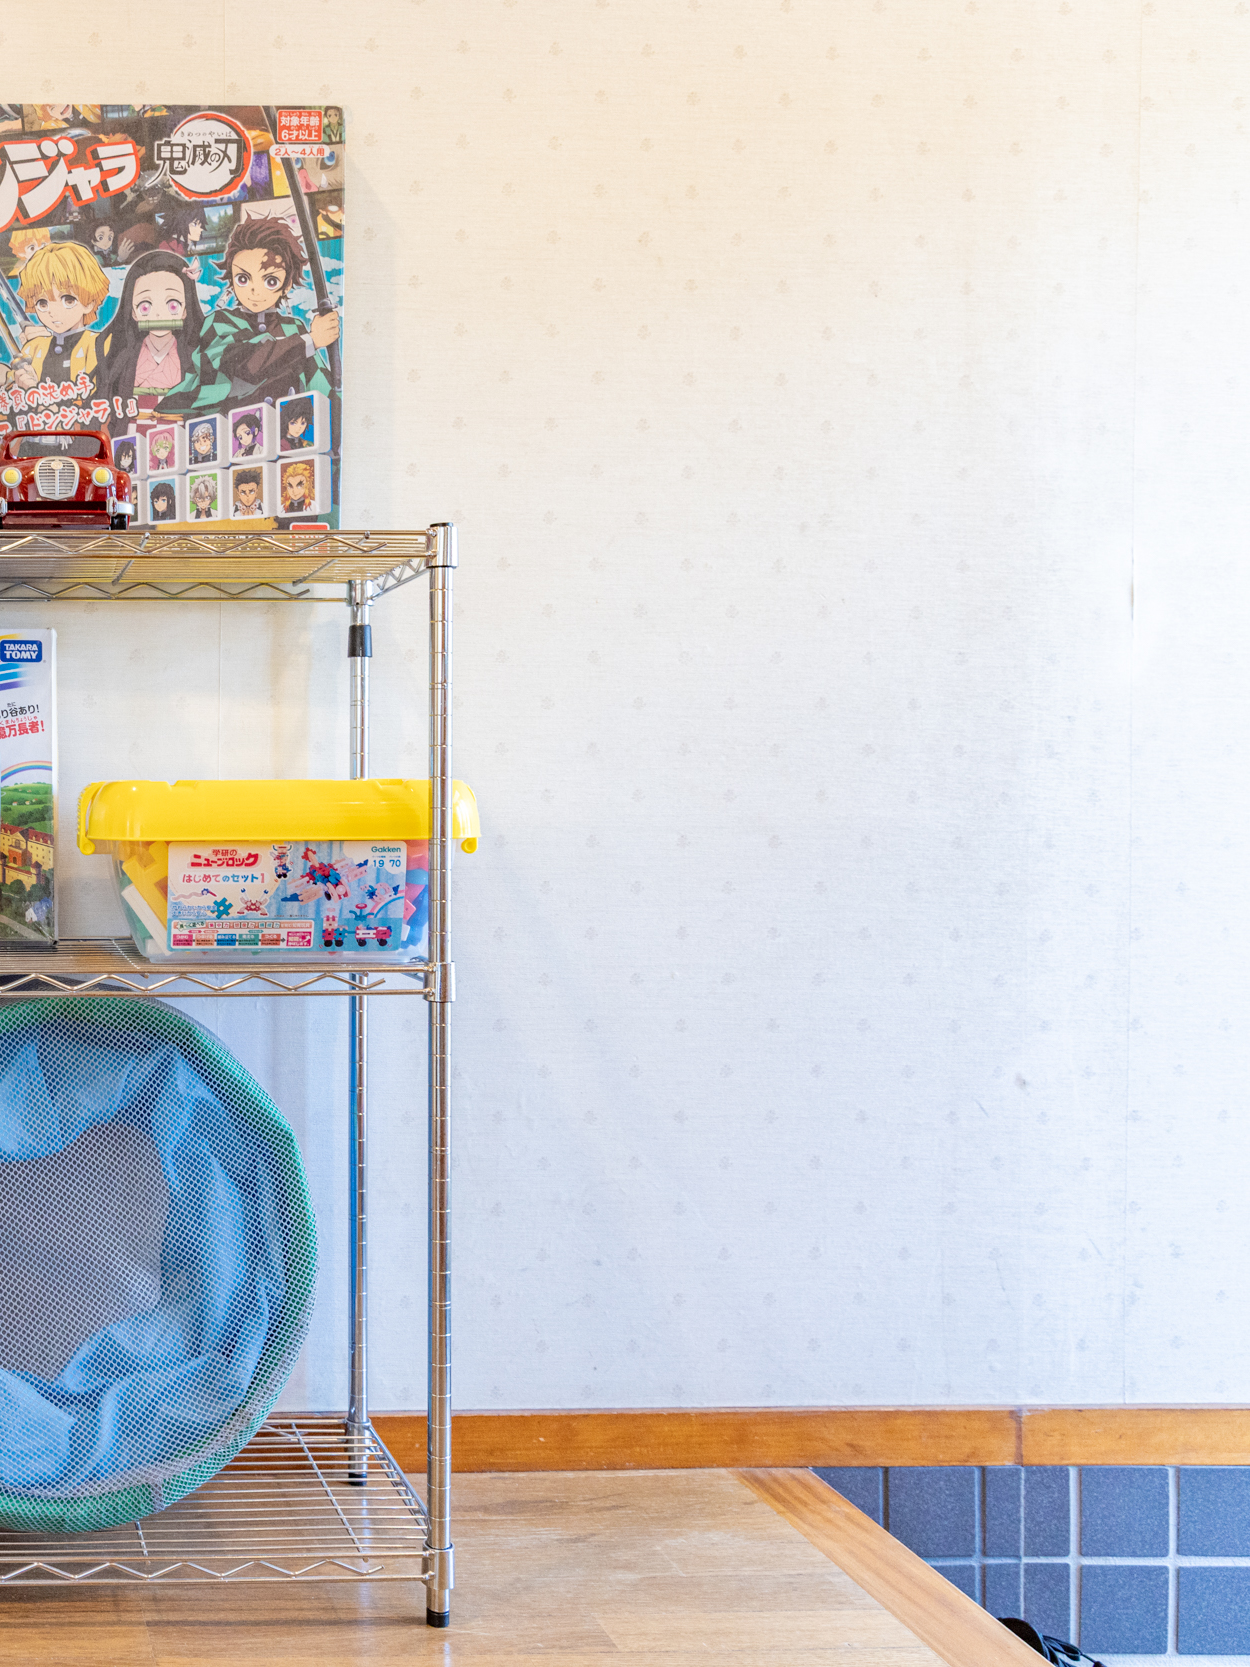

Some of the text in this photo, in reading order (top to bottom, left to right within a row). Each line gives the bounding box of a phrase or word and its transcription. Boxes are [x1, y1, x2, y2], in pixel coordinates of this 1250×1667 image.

[280, 116, 320, 126] 対象年齢
[281, 129, 319, 140] 6才以上
[152, 138, 244, 182] 鬼滅の刃
[4, 643, 39, 651] TAKARA
[4, 651, 38, 659] TOMY
[212, 849, 238, 857] 学研の
[190, 852, 259, 867] ニューブロック
[372, 859, 401, 868] 19 70
